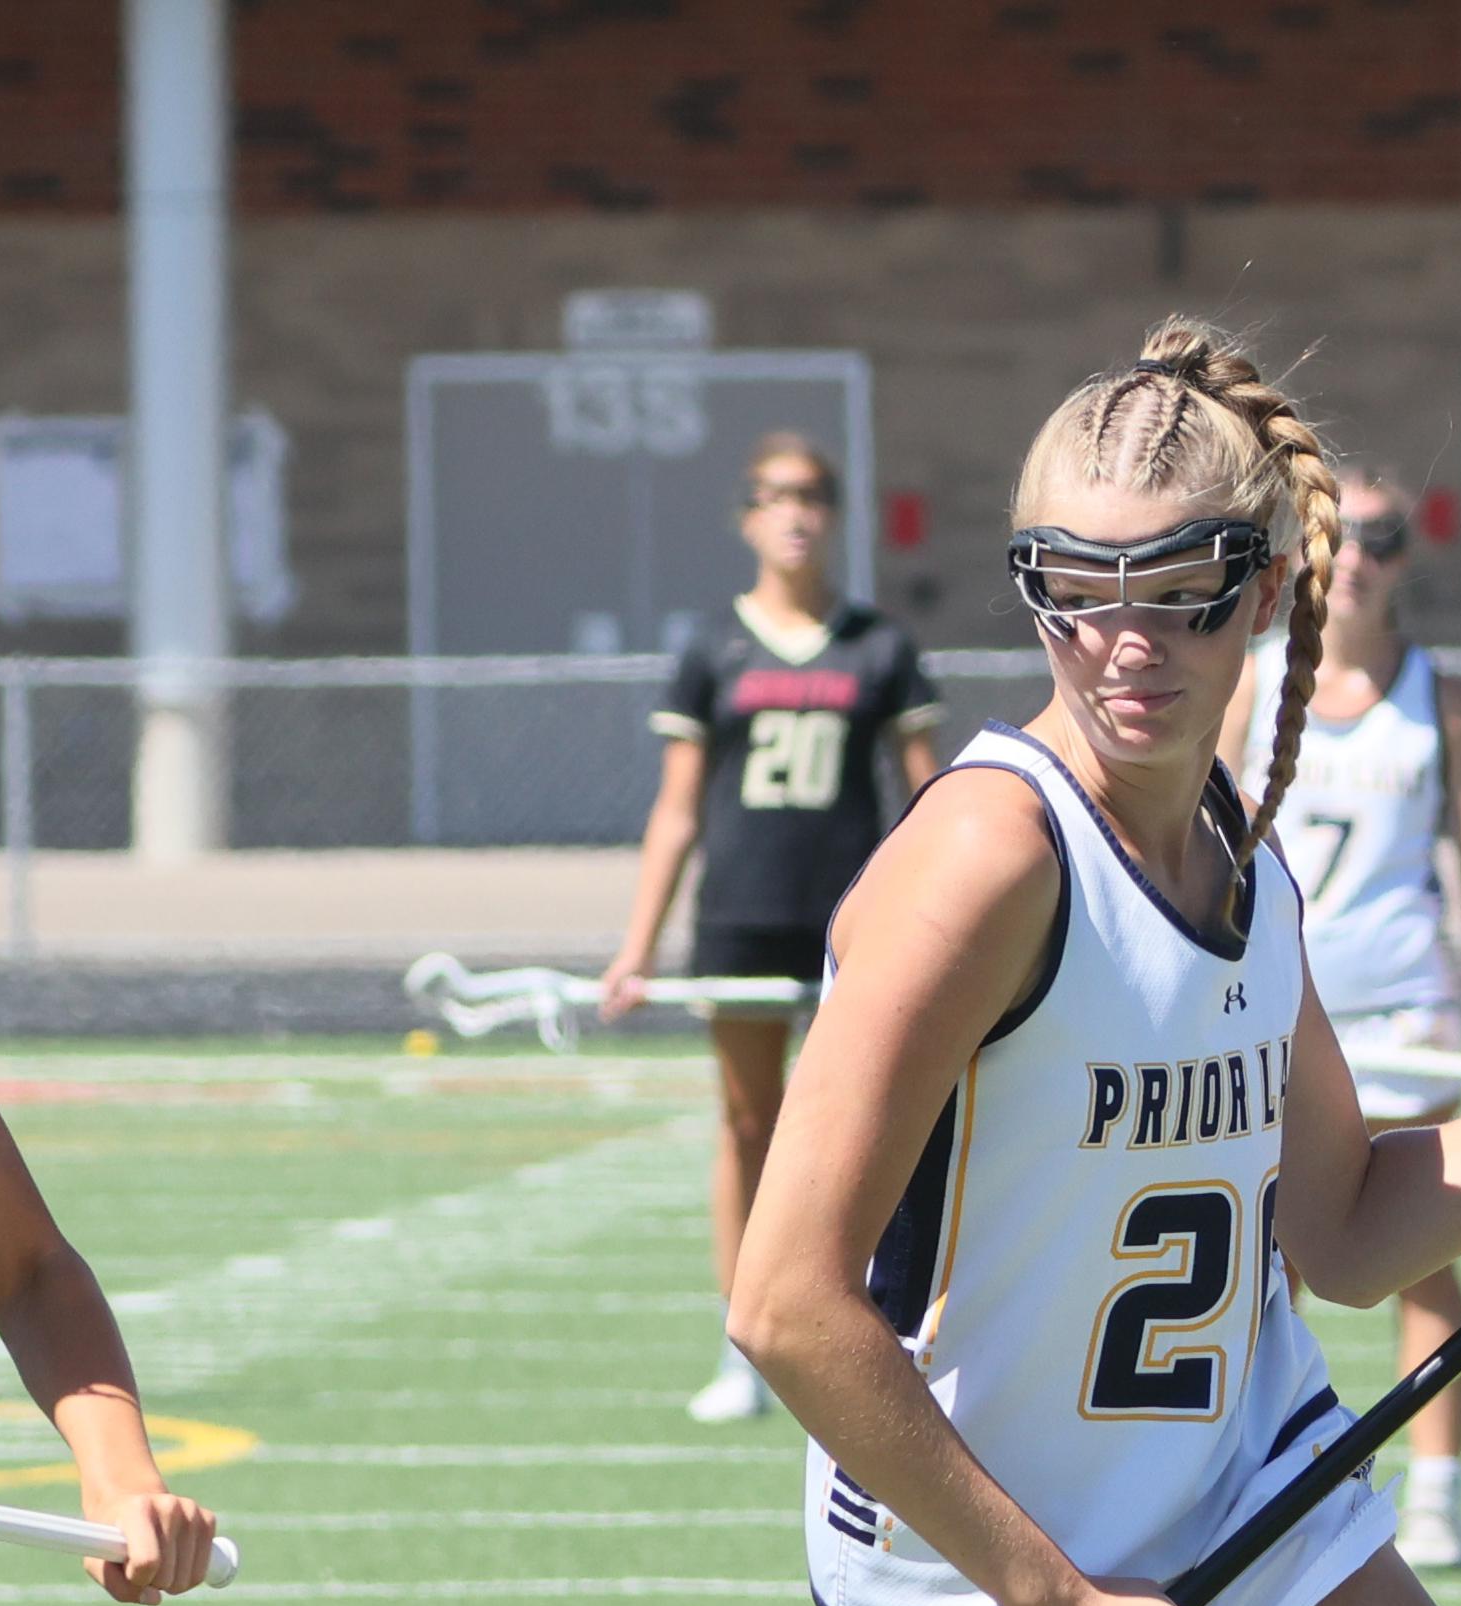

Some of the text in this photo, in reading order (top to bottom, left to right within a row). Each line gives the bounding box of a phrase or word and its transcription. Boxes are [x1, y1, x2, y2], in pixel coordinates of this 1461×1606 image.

[741, 709, 852, 812] 20
[1304, 809, 1356, 903] 7
[1077, 1050, 1252, 1151] PRIOR
[1076, 1165, 1280, 1423] 2
